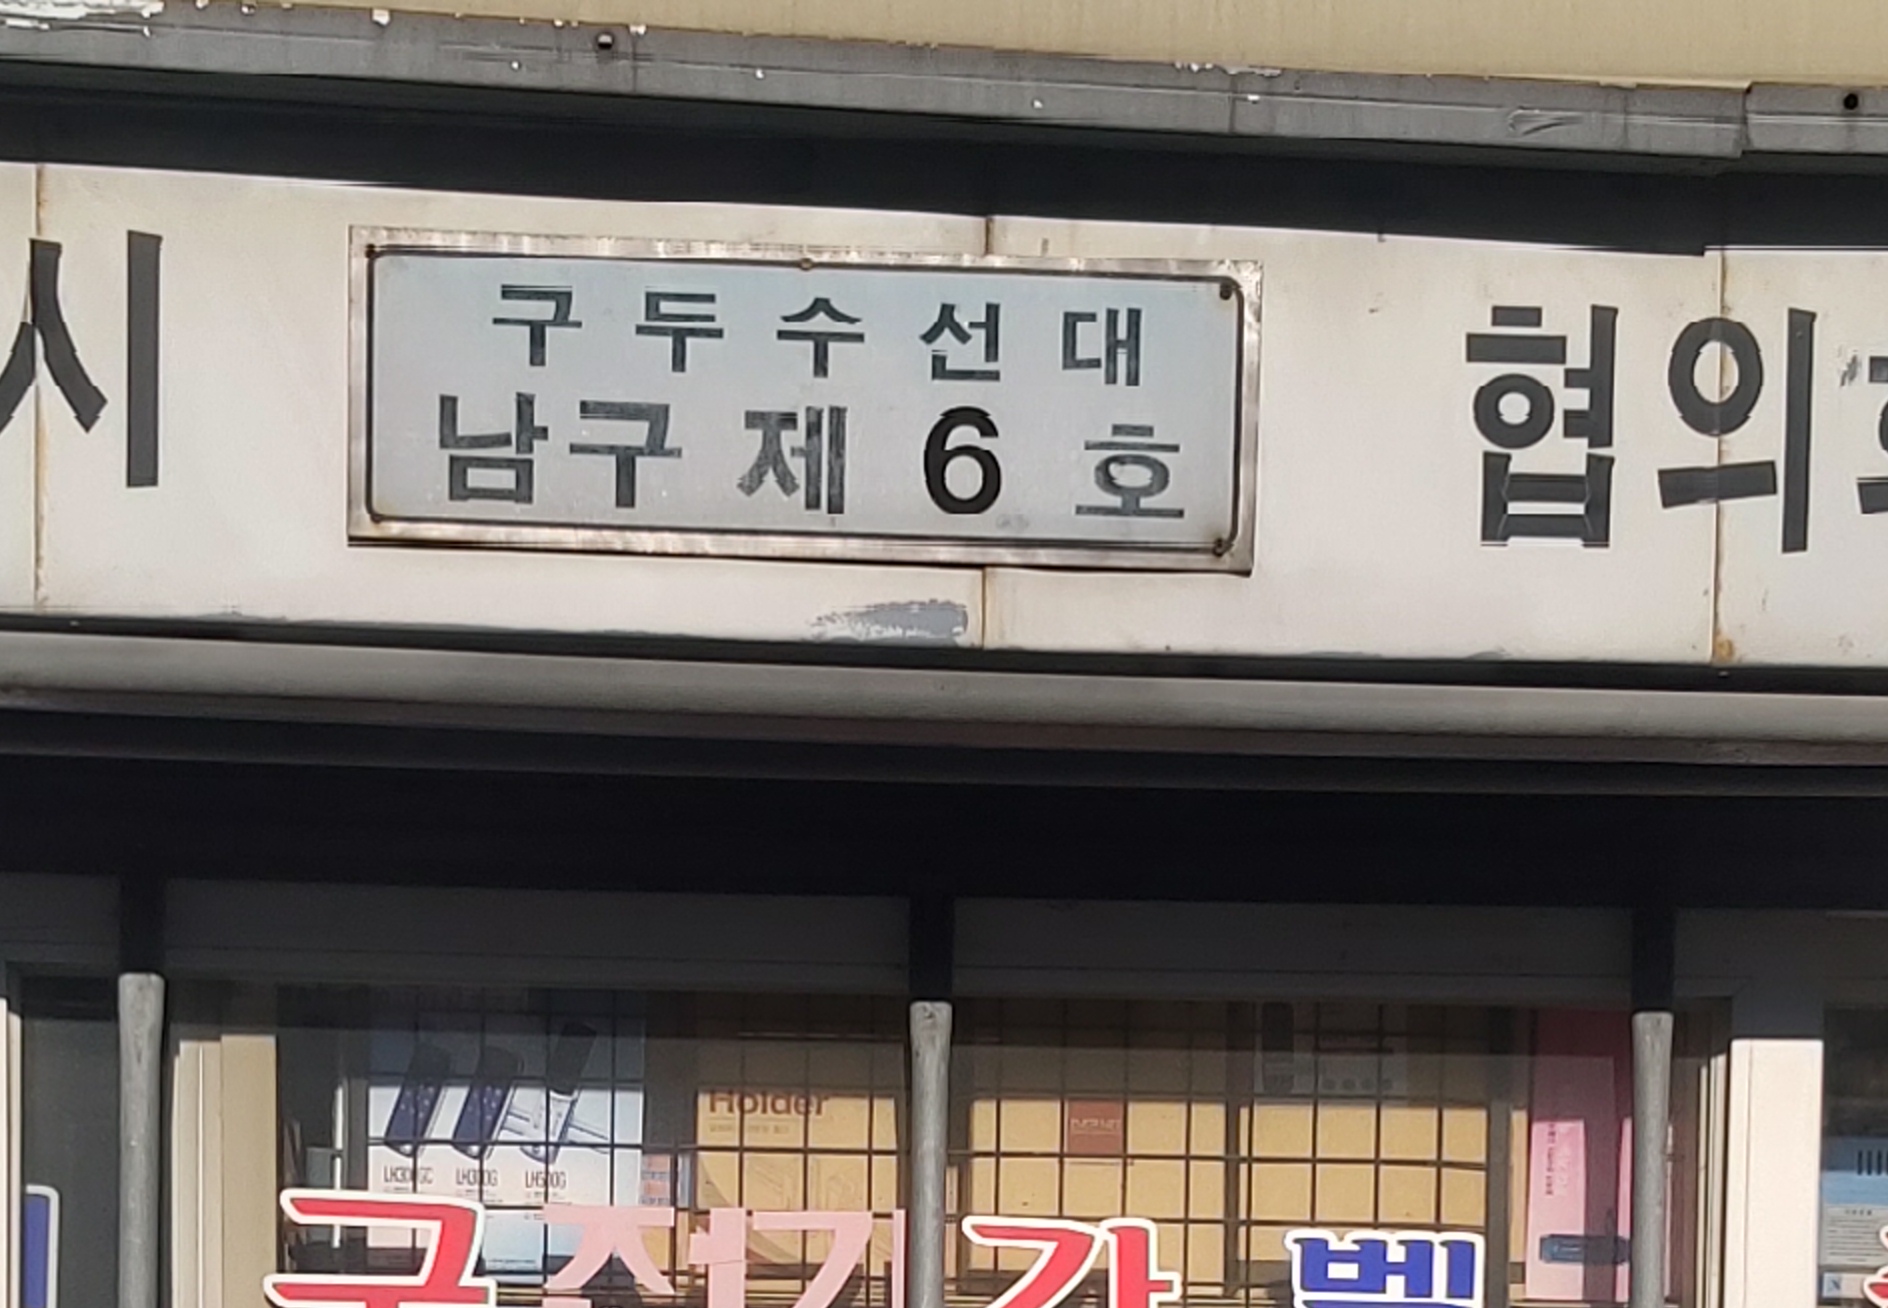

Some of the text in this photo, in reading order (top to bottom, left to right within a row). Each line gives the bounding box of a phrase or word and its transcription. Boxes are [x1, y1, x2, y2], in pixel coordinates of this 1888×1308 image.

[490, 283, 1144, 388] 구두수선대
[436, 391, 1186, 520] 남구 제 6 호
